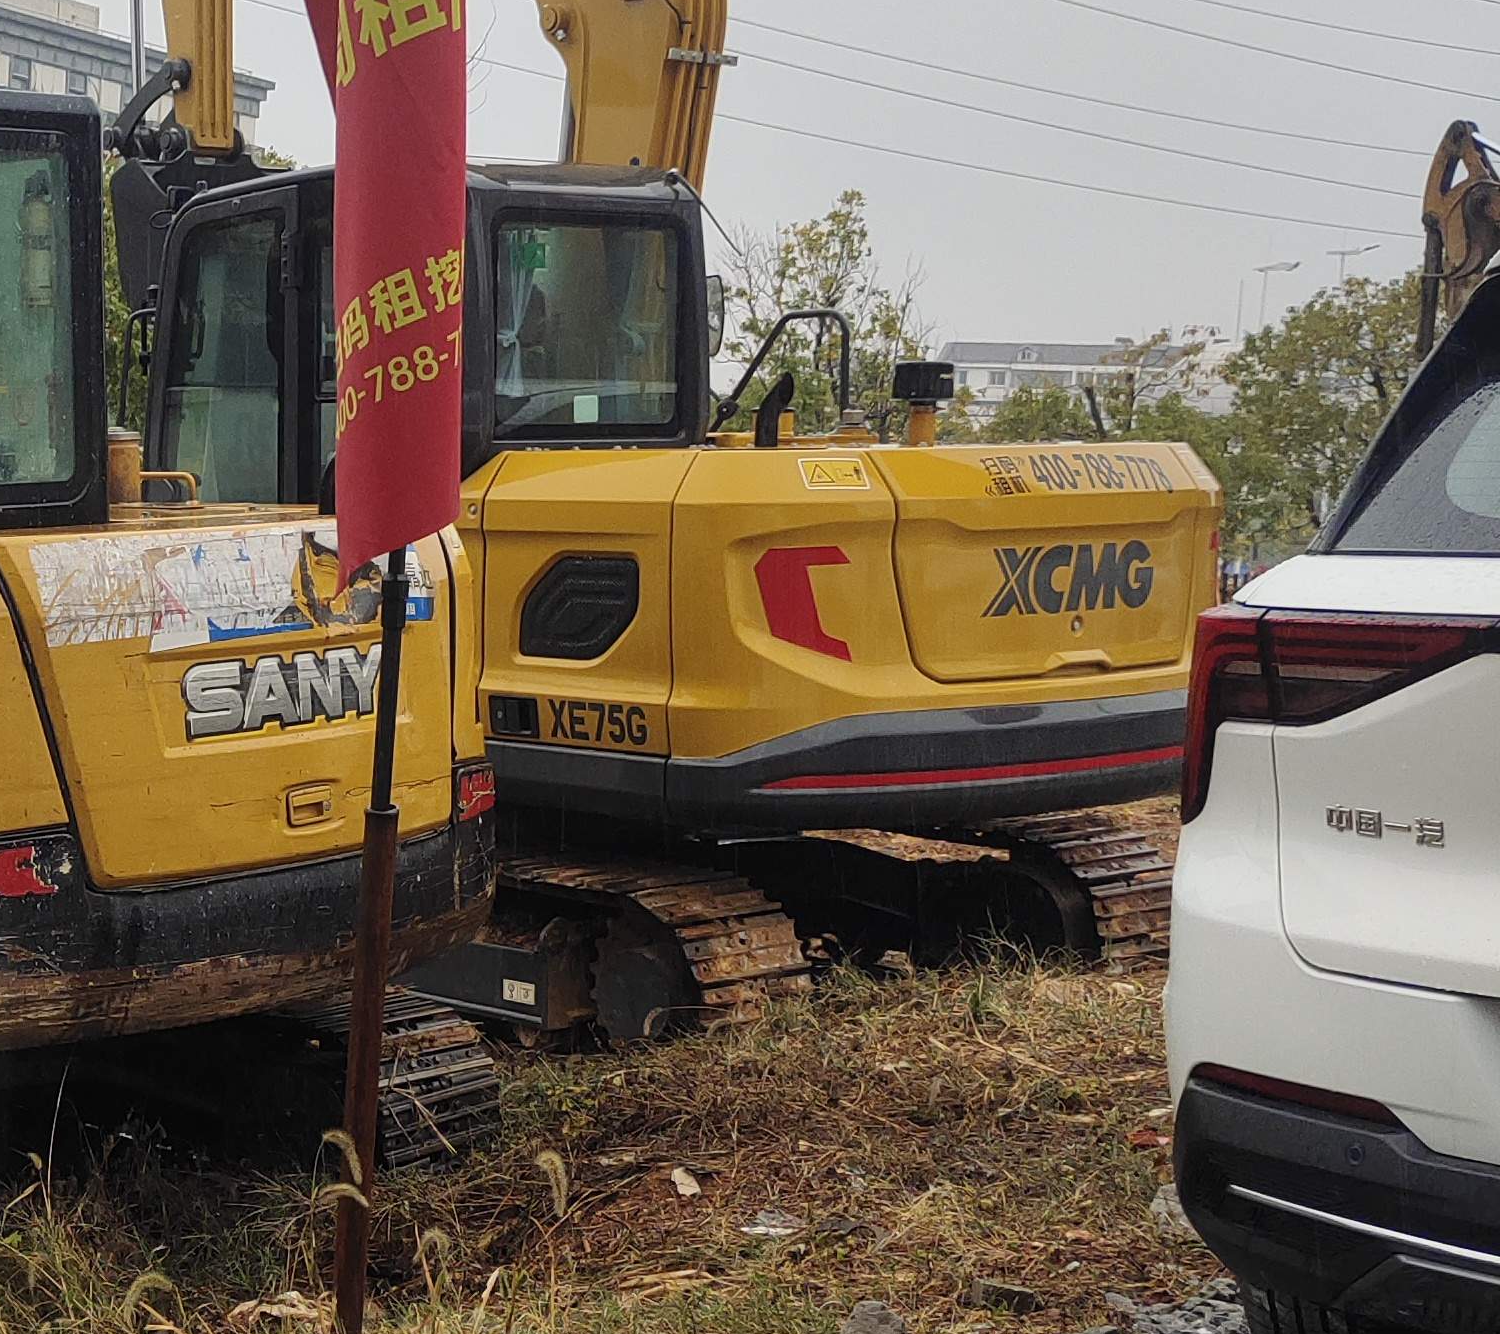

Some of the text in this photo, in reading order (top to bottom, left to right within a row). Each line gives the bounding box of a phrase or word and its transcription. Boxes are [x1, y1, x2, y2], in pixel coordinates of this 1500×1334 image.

[336, 237, 465, 379] 码租挖
[336, 324, 464, 441] 00-788-7
[1028, 452, 1174, 494] 400-788-7778
[980, 539, 1154, 618] XCMG
[182, 643, 382, 739] SANY
[547, 698, 649, 747] XE75G
[1325, 803, 1445, 849] 中国一汽
